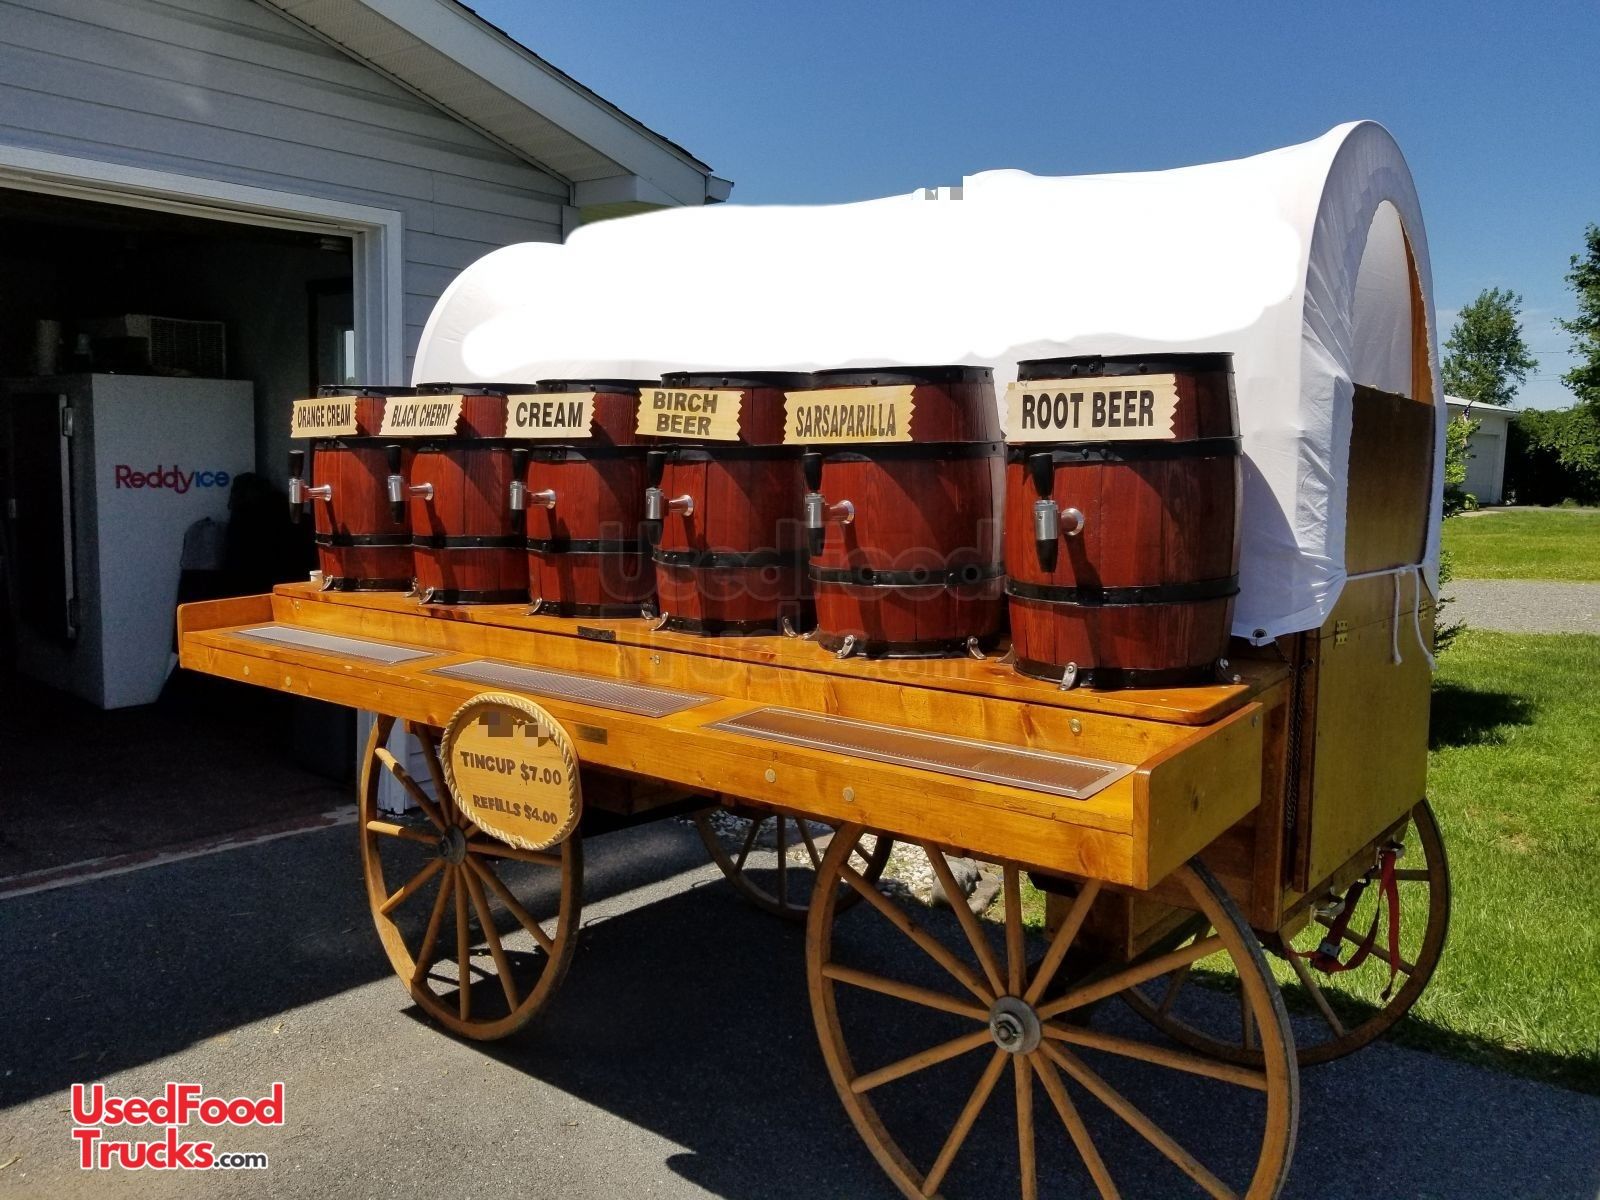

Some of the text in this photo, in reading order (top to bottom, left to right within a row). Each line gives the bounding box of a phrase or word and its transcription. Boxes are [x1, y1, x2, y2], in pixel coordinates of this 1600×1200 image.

[391, 404, 453, 427] BLACK CHERRY
[515, 401, 584, 428] CREAM
[653, 391, 718, 413] BIRCH
[1021, 390, 1154, 429] ROOT BEER
[297, 404, 350, 428] ORANGE CREAM
[656, 413, 711, 436] BEER
[796, 403, 897, 437] SARSAPARILLA
[460, 750, 562, 785] TINCUP $7.00
[472, 794, 558, 825] REFILLS $4.00
